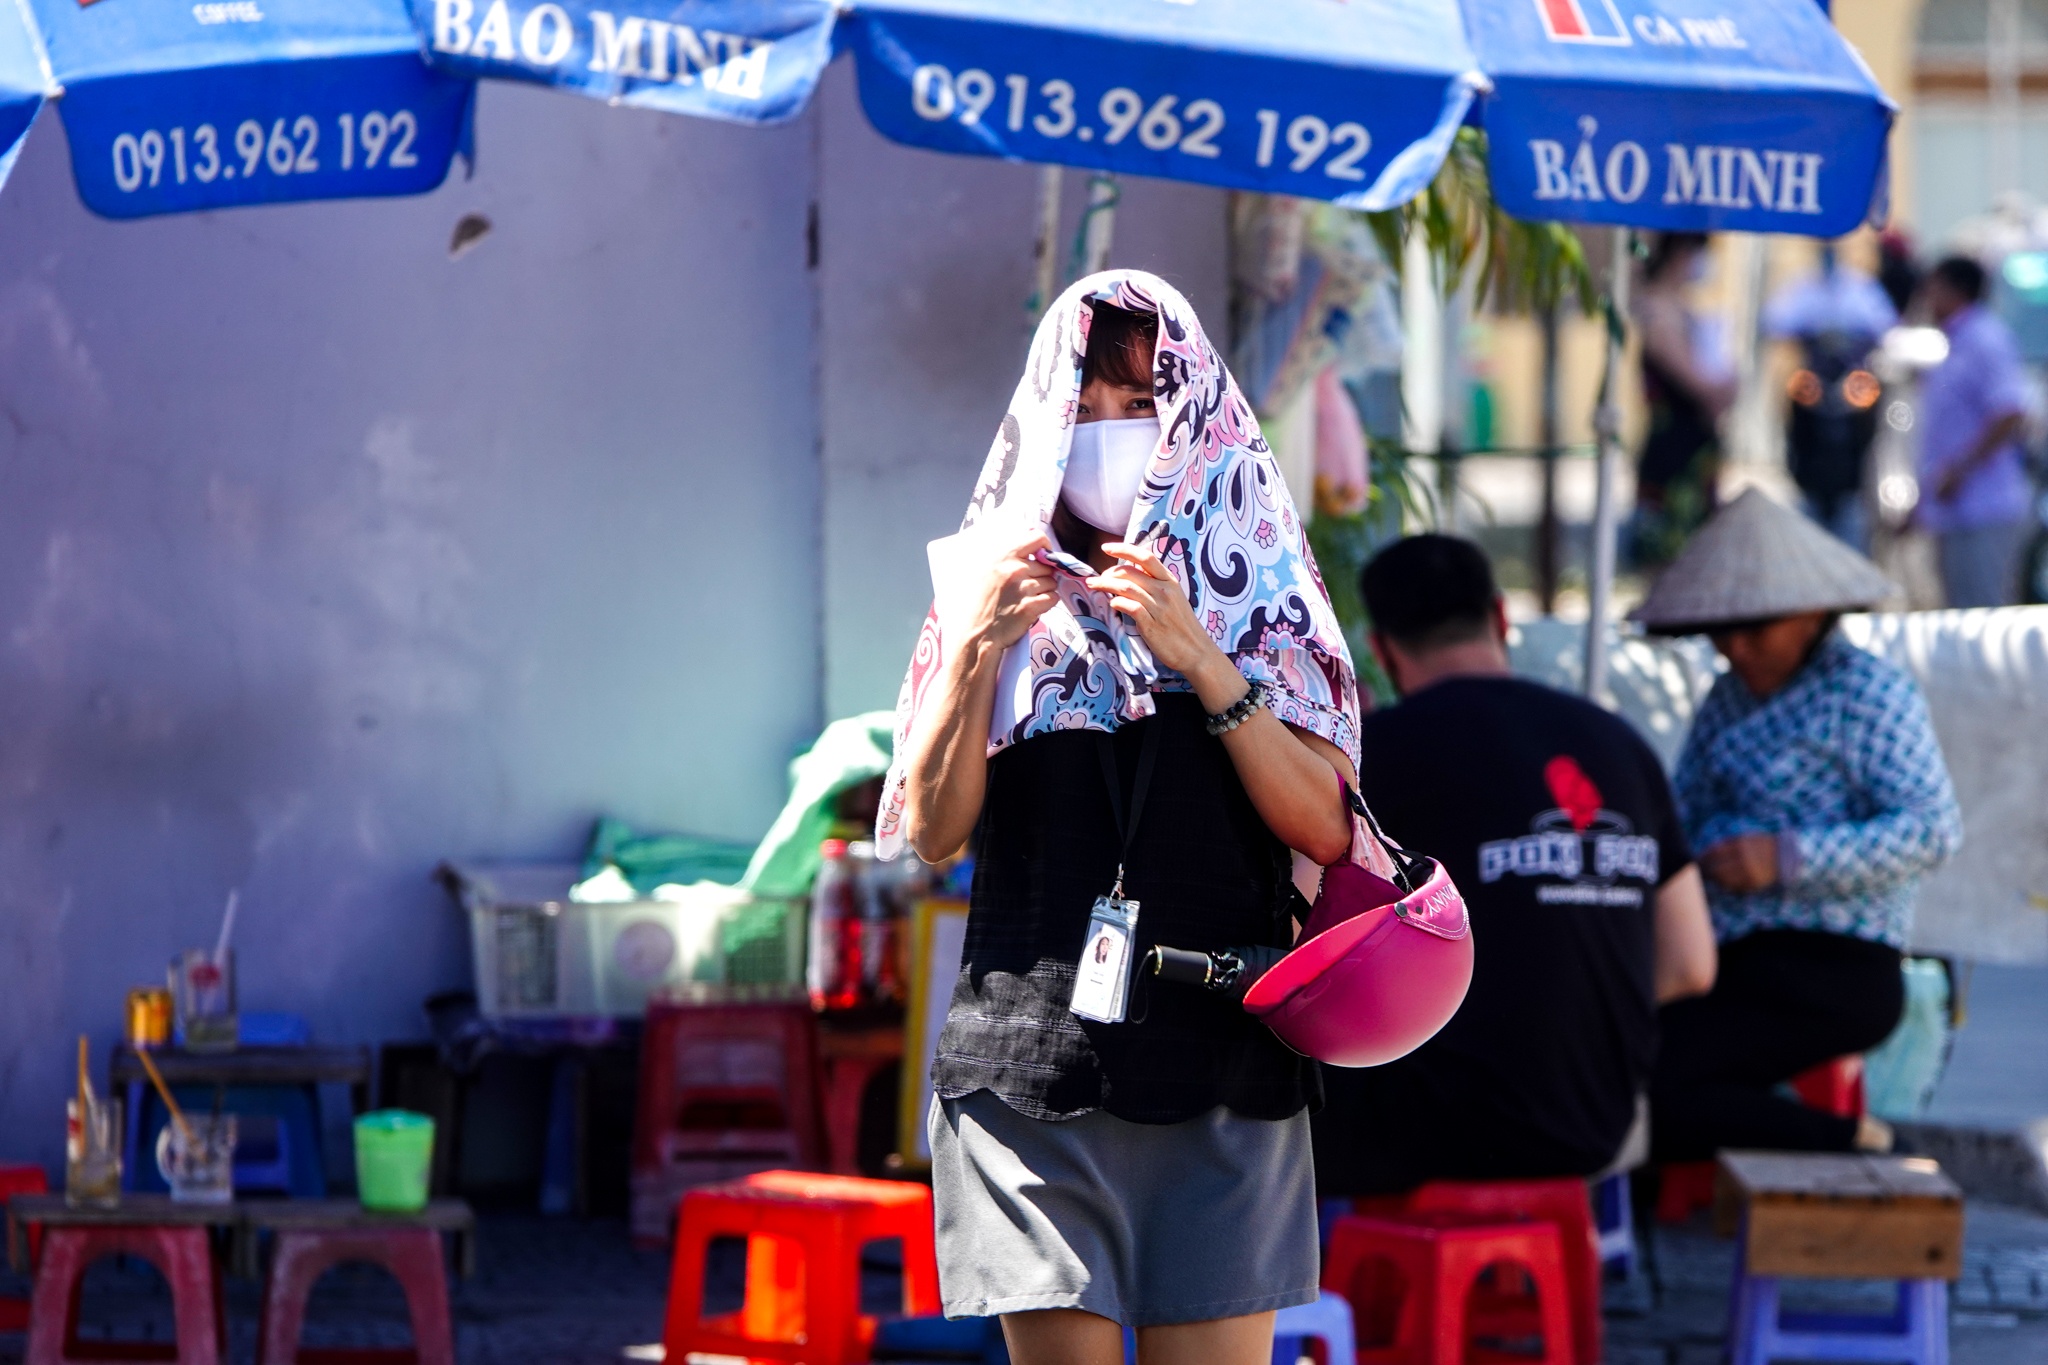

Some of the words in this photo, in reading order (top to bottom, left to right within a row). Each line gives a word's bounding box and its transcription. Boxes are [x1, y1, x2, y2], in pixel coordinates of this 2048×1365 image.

[586, 10, 776, 99] MINH
[112, 114, 319, 193] 0913.962
[339, 110, 419, 171] 192
[912, 63, 1226, 159] 0913.962
[1256, 109, 1372, 182] 192
[1529, 115, 1652, 204] BẢO
[1663, 143, 1823, 215] MINH
